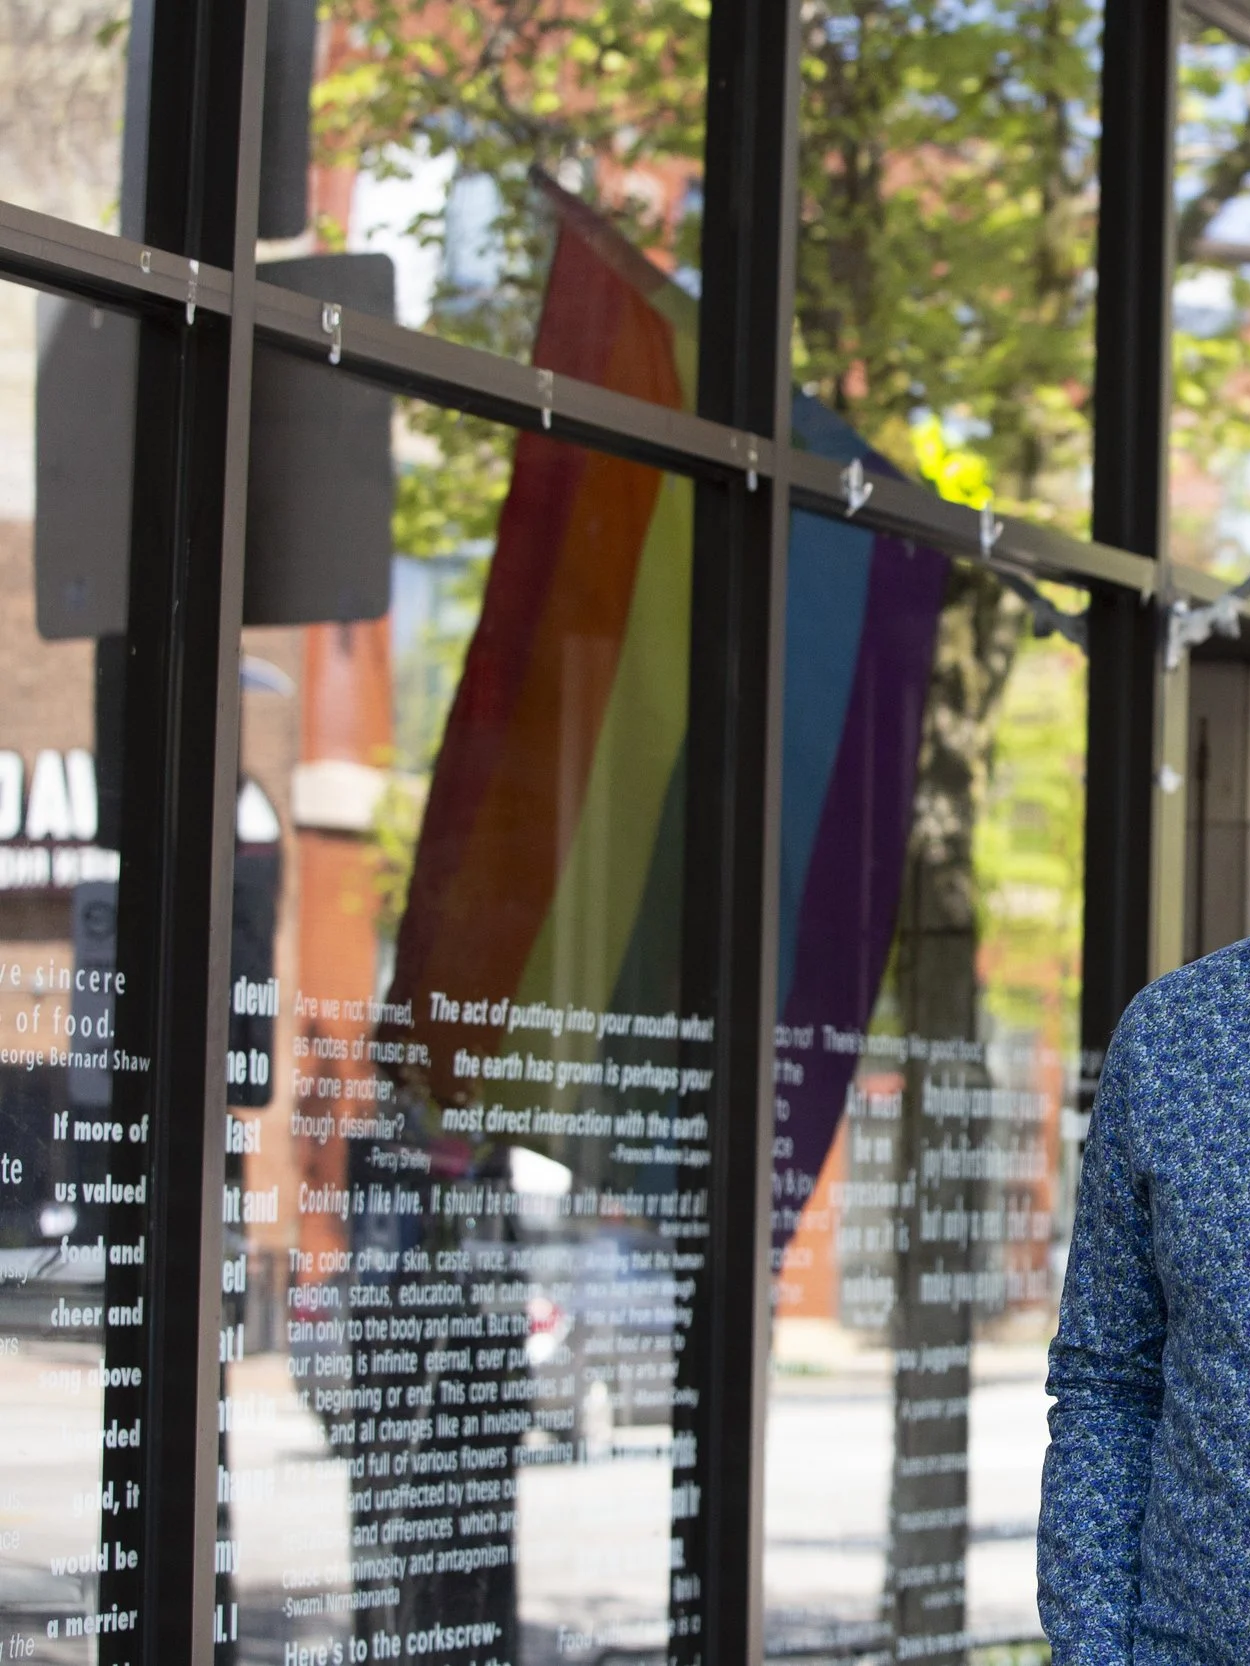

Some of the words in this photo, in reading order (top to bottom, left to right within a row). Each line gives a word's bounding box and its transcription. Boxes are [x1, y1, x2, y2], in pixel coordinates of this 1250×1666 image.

[35, 958, 127, 995] sincere
[234, 975, 280, 1016] devil
[293, 990, 318, 1018] Are
[322, 997, 340, 1020] we
[344, 998, 365, 1022] not
[368, 995, 415, 1029] formed,
[16, 1004, 41, 1034] of
[53, 1005, 115, 1039] food.
[430, 991, 460, 1023] The
[462, 996, 488, 1026] act
[490, 996, 509, 1026] of
[507, 1003, 564, 1038] putting
[565, 1004, 596, 1033] into
[597, 1013, 631, 1042] your
[633, 1011, 678, 1040] mouth
[680, 1013, 714, 1042] what
[50, 1046, 108, 1070] Bernard
[113, 1049, 151, 1073] Shaw
[249, 1048, 269, 1085] to
[293, 1035, 309, 1058] as
[314, 1037, 349, 1061] notes
[352, 1033, 365, 1061] of
[368, 1039, 404, 1064] music
[407, 1043, 431, 1068] are,
[291, 1069, 314, 1097] For
[318, 1076, 341, 1099] one
[344, 1072, 397, 1105] another,
[453, 1048, 480, 1078] the
[482, 1050, 524, 1081] earth
[526, 1051, 554, 1082] has
[556, 1061, 603, 1090] grown
[605, 1056, 619, 1086] is
[620, 1060, 678, 1095] perhaps
[679, 1068, 713, 1097] your
[53, 1111, 69, 1141] If
[73, 1120, 123, 1143] more
[129, 1114, 149, 1144] of
[226, 1114, 262, 1154] last
[291, 1112, 335, 1146] though
[339, 1111, 405, 1141] dissimilar?
[442, 1106, 483, 1133] most
[485, 1103, 532, 1134] direct
[533, 1106, 612, 1137] interaction
[614, 1110, 646, 1138] with
[647, 1109, 670, 1139] the
[671, 1112, 709, 1141] earth
[54, 1182, 77, 1203] us
[82, 1173, 147, 1205] valued
[243, 1185, 279, 1223] and
[299, 1181, 350, 1221] Cooking
[353, 1183, 365, 1215] is
[367, 1183, 392, 1215] like
[394, 1183, 424, 1216] love.
[430, 1184, 441, 1215] It
[443, 1184, 485, 1217] should
[486, 1185, 500, 1216] be
[660, 1189, 679, 1217] not
[60, 1234, 105, 1264] food
[110, 1235, 145, 1265] and
[288, 1247, 313, 1272] The
[317, 1247, 354, 1272] color
[356, 1246, 371, 1272] of
[374, 1248, 400, 1272] our
[435, 1249, 473, 1274] caste,
[50, 1297, 103, 1328] cheer
[108, 1296, 144, 1327] and
[288, 1282, 342, 1311] religion,
[348, 1283, 393, 1310] status,
[398, 1282, 466, 1307] education,
[470, 1280, 496, 1305] and
[287, 1316, 314, 1342] tain
[316, 1317, 346, 1346] only
[348, 1318, 363, 1341] to
[364, 1316, 388, 1341] the
[389, 1314, 422, 1344] body
[424, 1313, 449, 1340] and
[451, 1312, 486, 1339] mind.
[488, 1310, 511, 1337] But
[38, 1369, 82, 1395] song
[87, 1358, 143, 1388] above
[288, 1354, 311, 1377] our
[314, 1350, 353, 1381] being
[356, 1350, 368, 1376] is
[424, 1346, 474, 1373] eternal,
[476, 1348, 506, 1371] ever
[315, 1385, 382, 1417] beginning
[386, 1386, 403, 1409] or
[405, 1382, 436, 1408] end.
[439, 1379, 466, 1405] This
[469, 1381, 499, 1404] core
[501, 1375, 557, 1401] underlies
[330, 1419, 356, 1445] and
[359, 1416, 376, 1444] all
[378, 1415, 433, 1446] changes
[436, 1412, 460, 1439] like
[461, 1415, 480, 1437] an
[481, 1409, 532, 1435] invisible
[533, 1406, 575, 1430] thread
[368, 1451, 391, 1477] full
[393, 1449, 409, 1476] of
[411, 1447, 458, 1475] various
[72, 1480, 120, 1517] gold,
[126, 1480, 141, 1510] it
[348, 1488, 372, 1513] and
[375, 1483, 445, 1511] unaffected
[448, 1481, 464, 1508] by
[465, 1477, 500, 1504] these
[353, 1520, 378, 1546] and
[381, 1516, 454, 1544] differences
[458, 1509, 498, 1536] which
[50, 1543, 110, 1577] would
[115, 1541, 139, 1571] be
[408, 1550, 434, 1576] and
[436, 1543, 509, 1574] antagonism
[326, 1586, 401, 1614] Nirmalananda
[47, 1618, 59, 1639] a
[66, 1603, 139, 1637] merrier
[9, 1632, 36, 1660] the
[284, 1637, 344, 1666] Here's
[349, 1636, 368, 1663] to
[371, 1628, 402, 1659] the
[405, 1621, 502, 1656] corkscrew-
